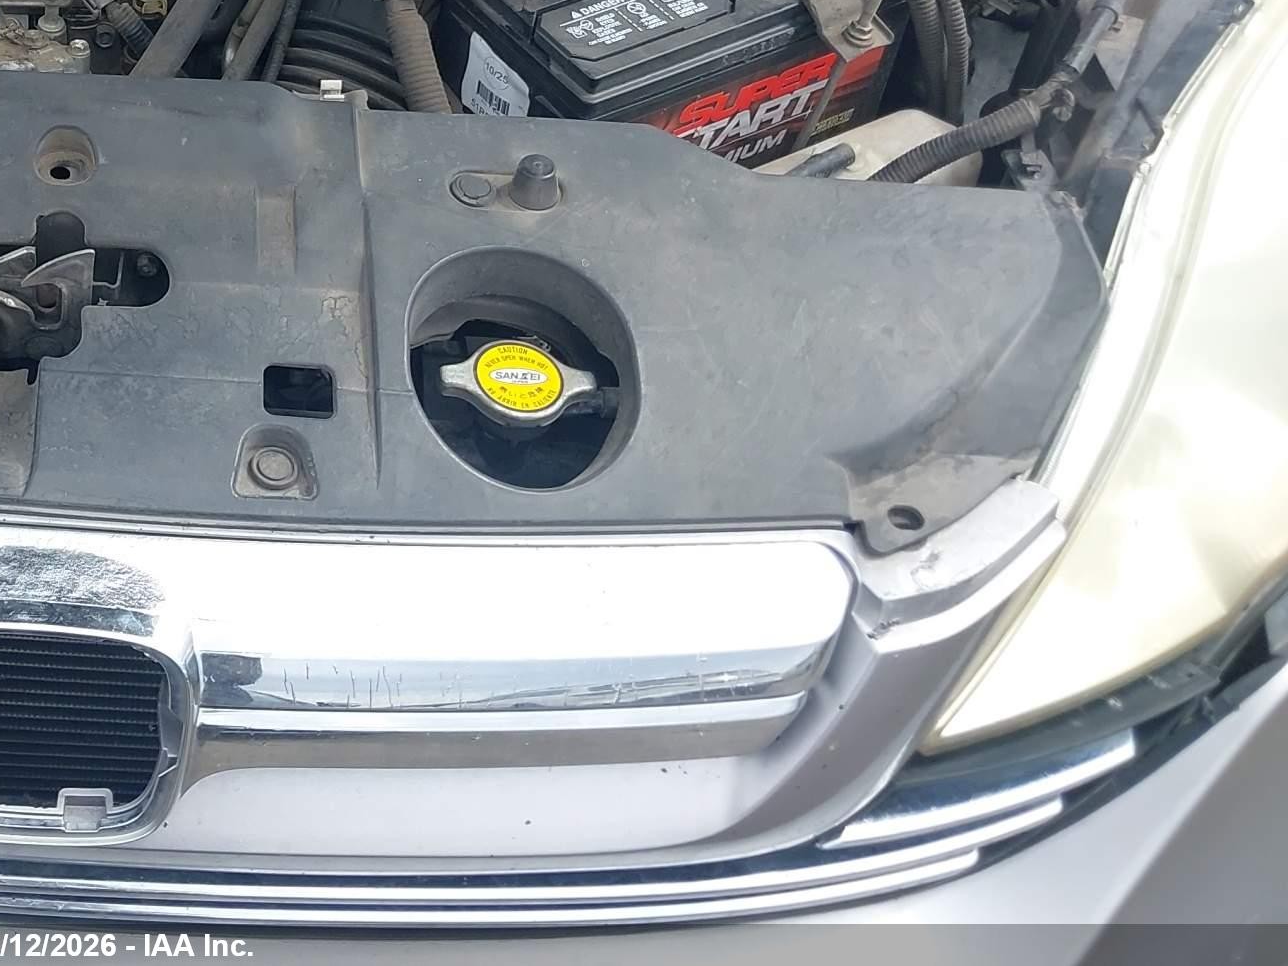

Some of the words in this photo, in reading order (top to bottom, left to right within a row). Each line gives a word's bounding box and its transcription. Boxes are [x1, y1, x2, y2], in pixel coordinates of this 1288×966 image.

[486, 62, 509, 85] 10/25
[679, 53, 837, 126] SUPER
[497, 346, 528, 355] CAUTION
